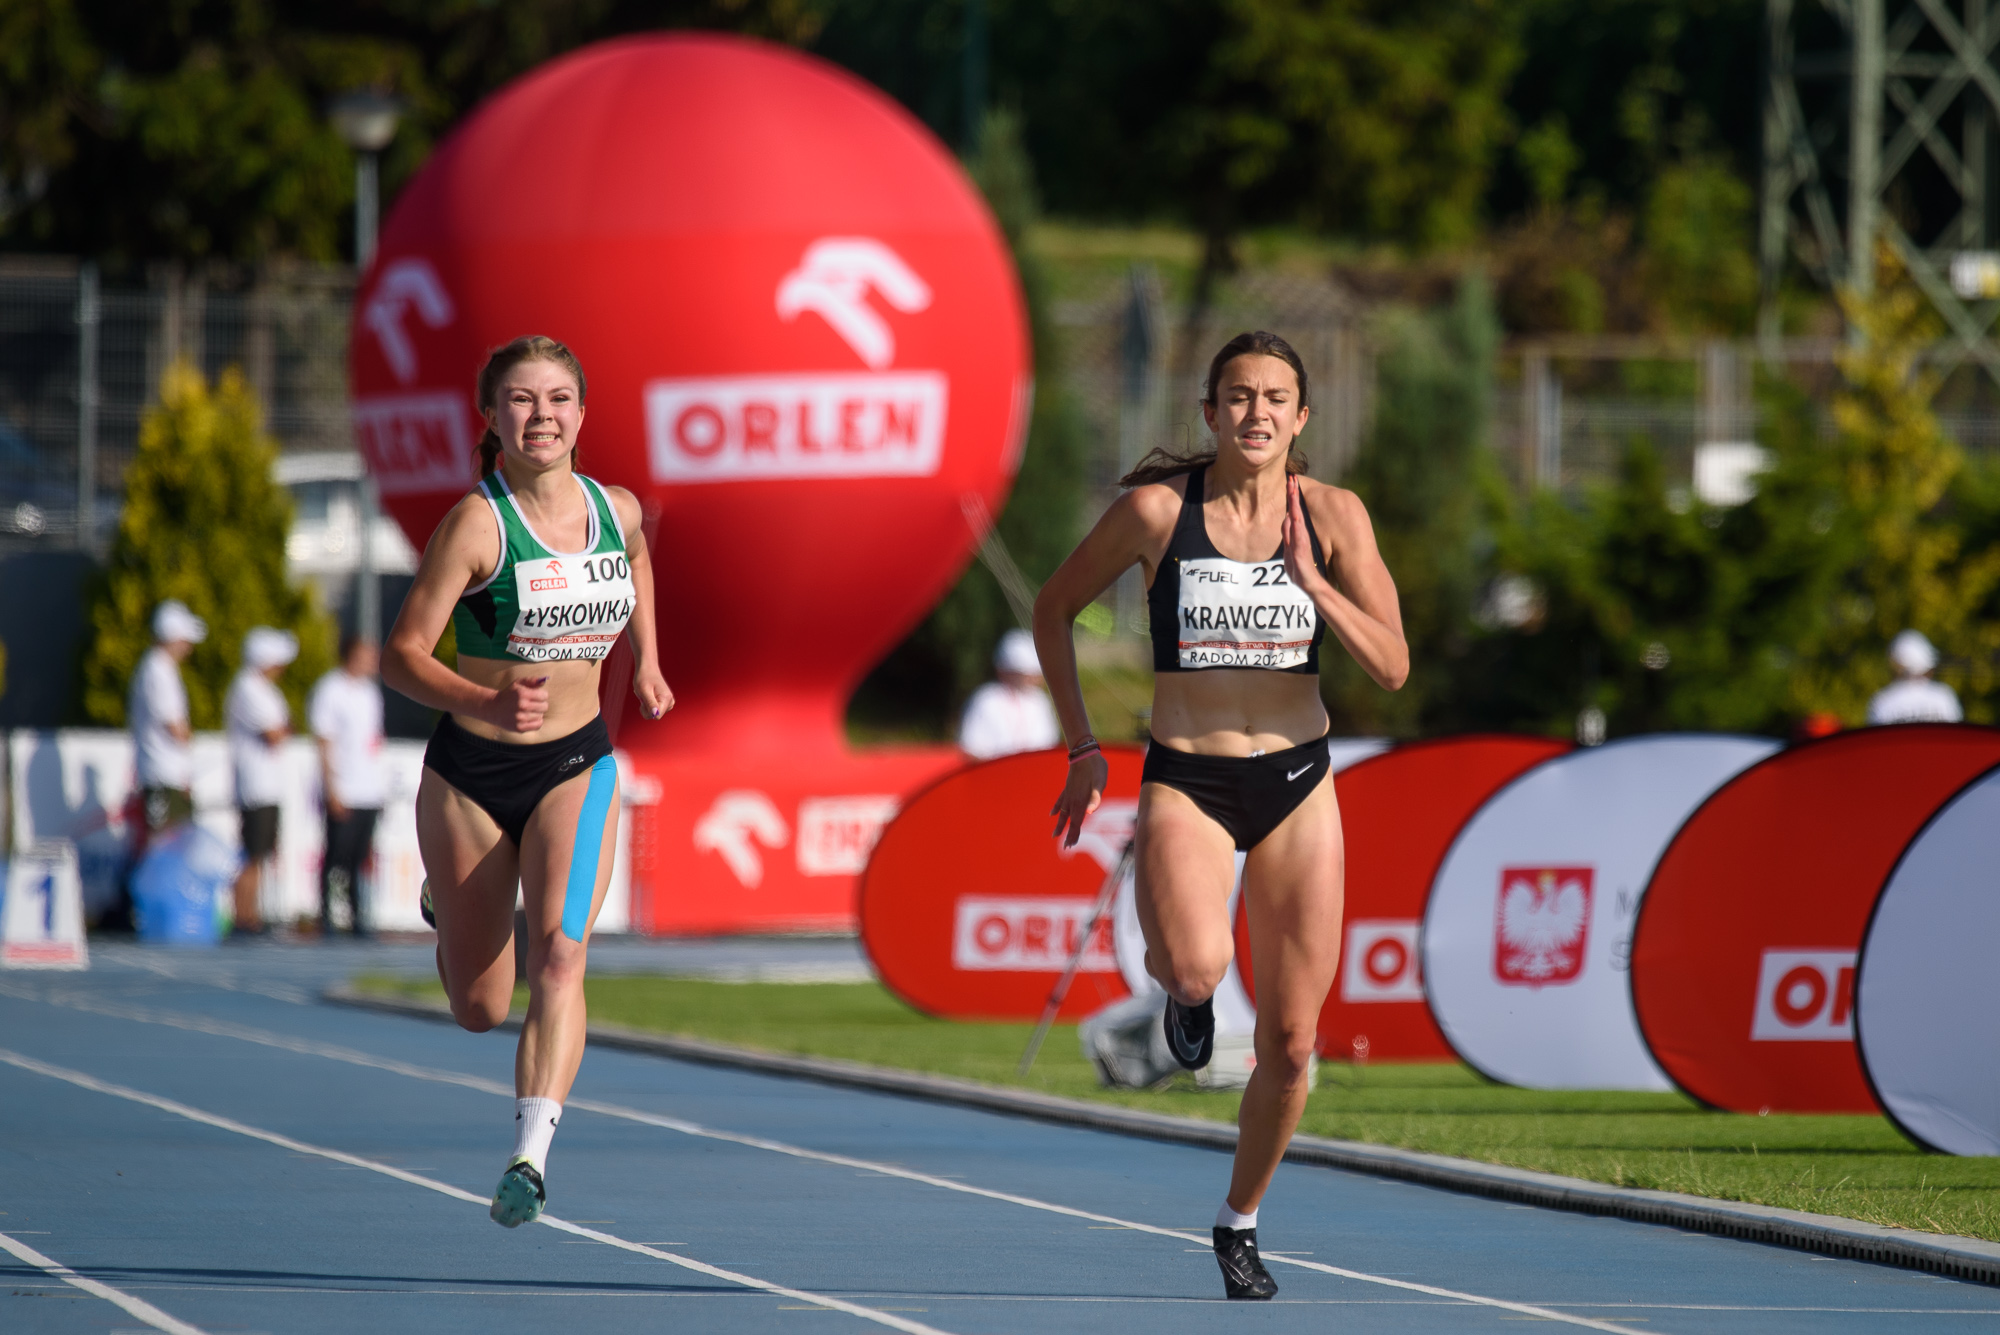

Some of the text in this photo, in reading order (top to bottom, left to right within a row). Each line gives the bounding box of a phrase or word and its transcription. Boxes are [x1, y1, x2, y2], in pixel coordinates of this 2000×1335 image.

[673, 399, 918, 458] ORLEN
[583, 556, 628, 583] 100
[1199, 571, 1239, 585] FUEL
[531, 578, 567, 591] ORLEN
[524, 598, 630, 628] ŁYSKOWKA
[1184, 605, 1311, 630] KRAWCZYK
[517, 646, 606, 660] RADOM 2022
[1190, 651, 1285, 666] RADOM 2022
